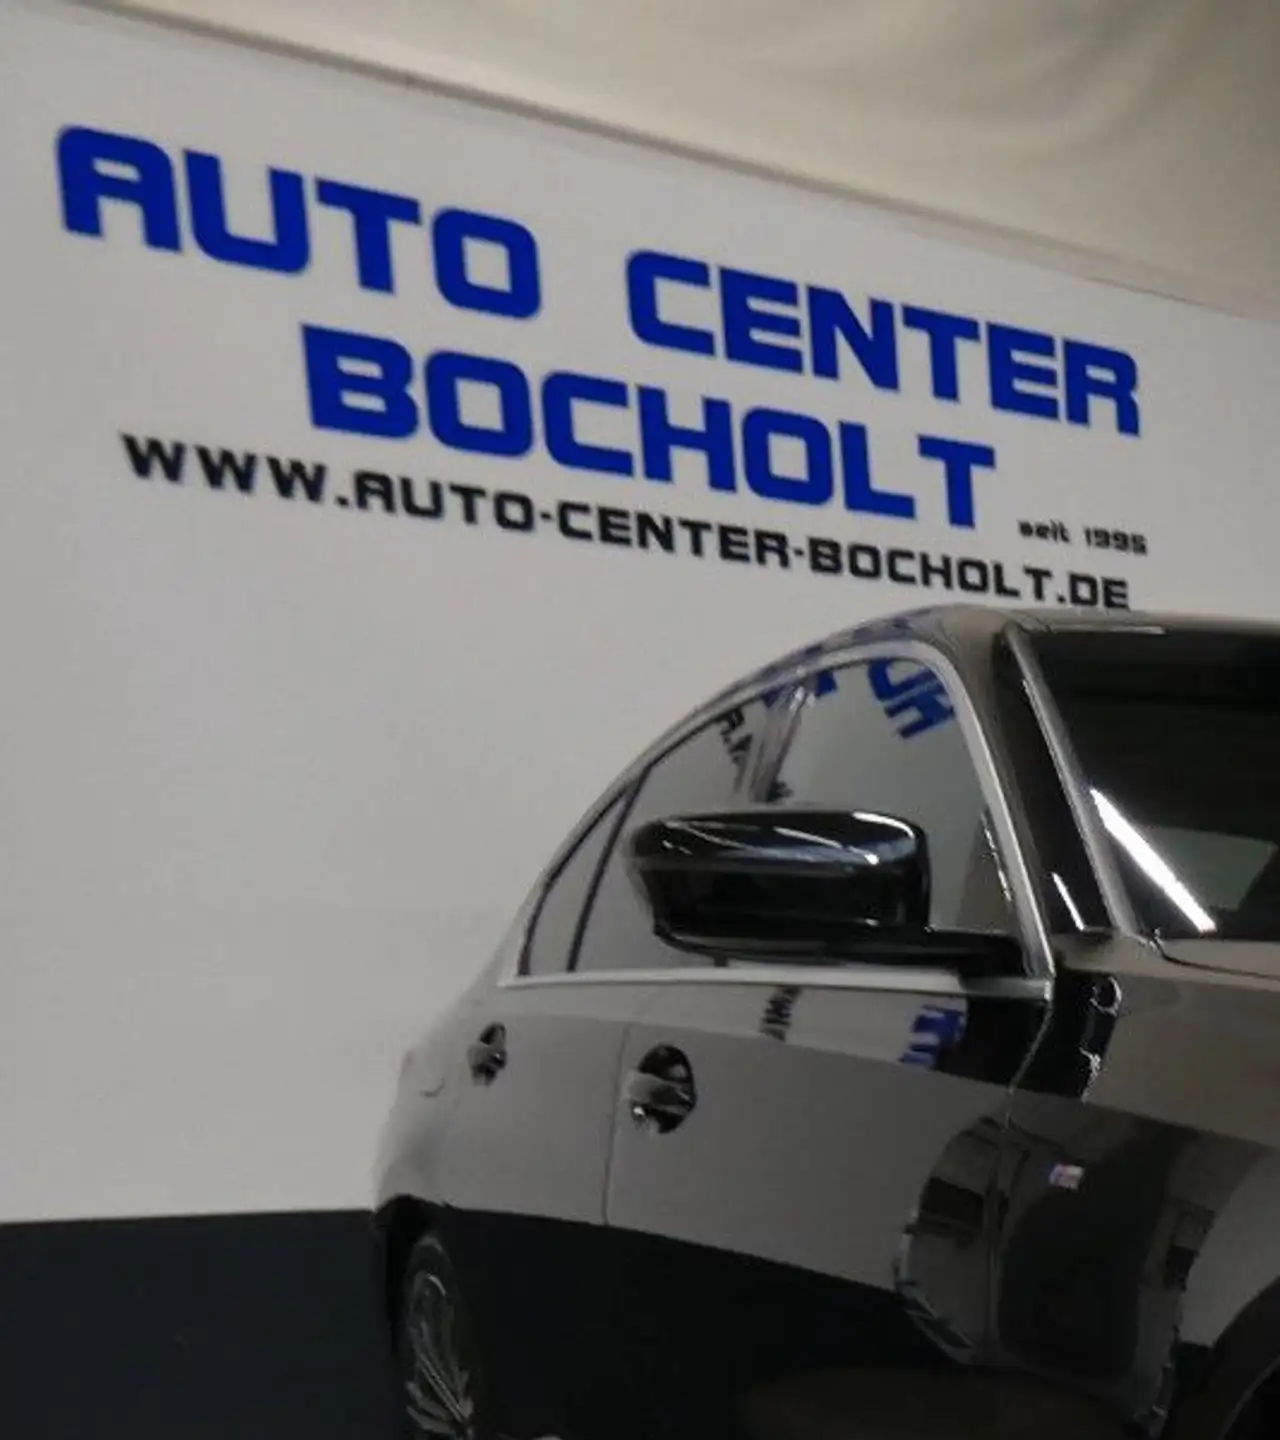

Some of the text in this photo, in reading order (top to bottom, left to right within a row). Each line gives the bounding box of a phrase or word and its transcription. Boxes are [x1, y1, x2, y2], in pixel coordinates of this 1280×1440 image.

[57, 127, 1141, 436] AUTO CENTER
[303, 326, 1146, 554] BOCHOLT seit 1995
